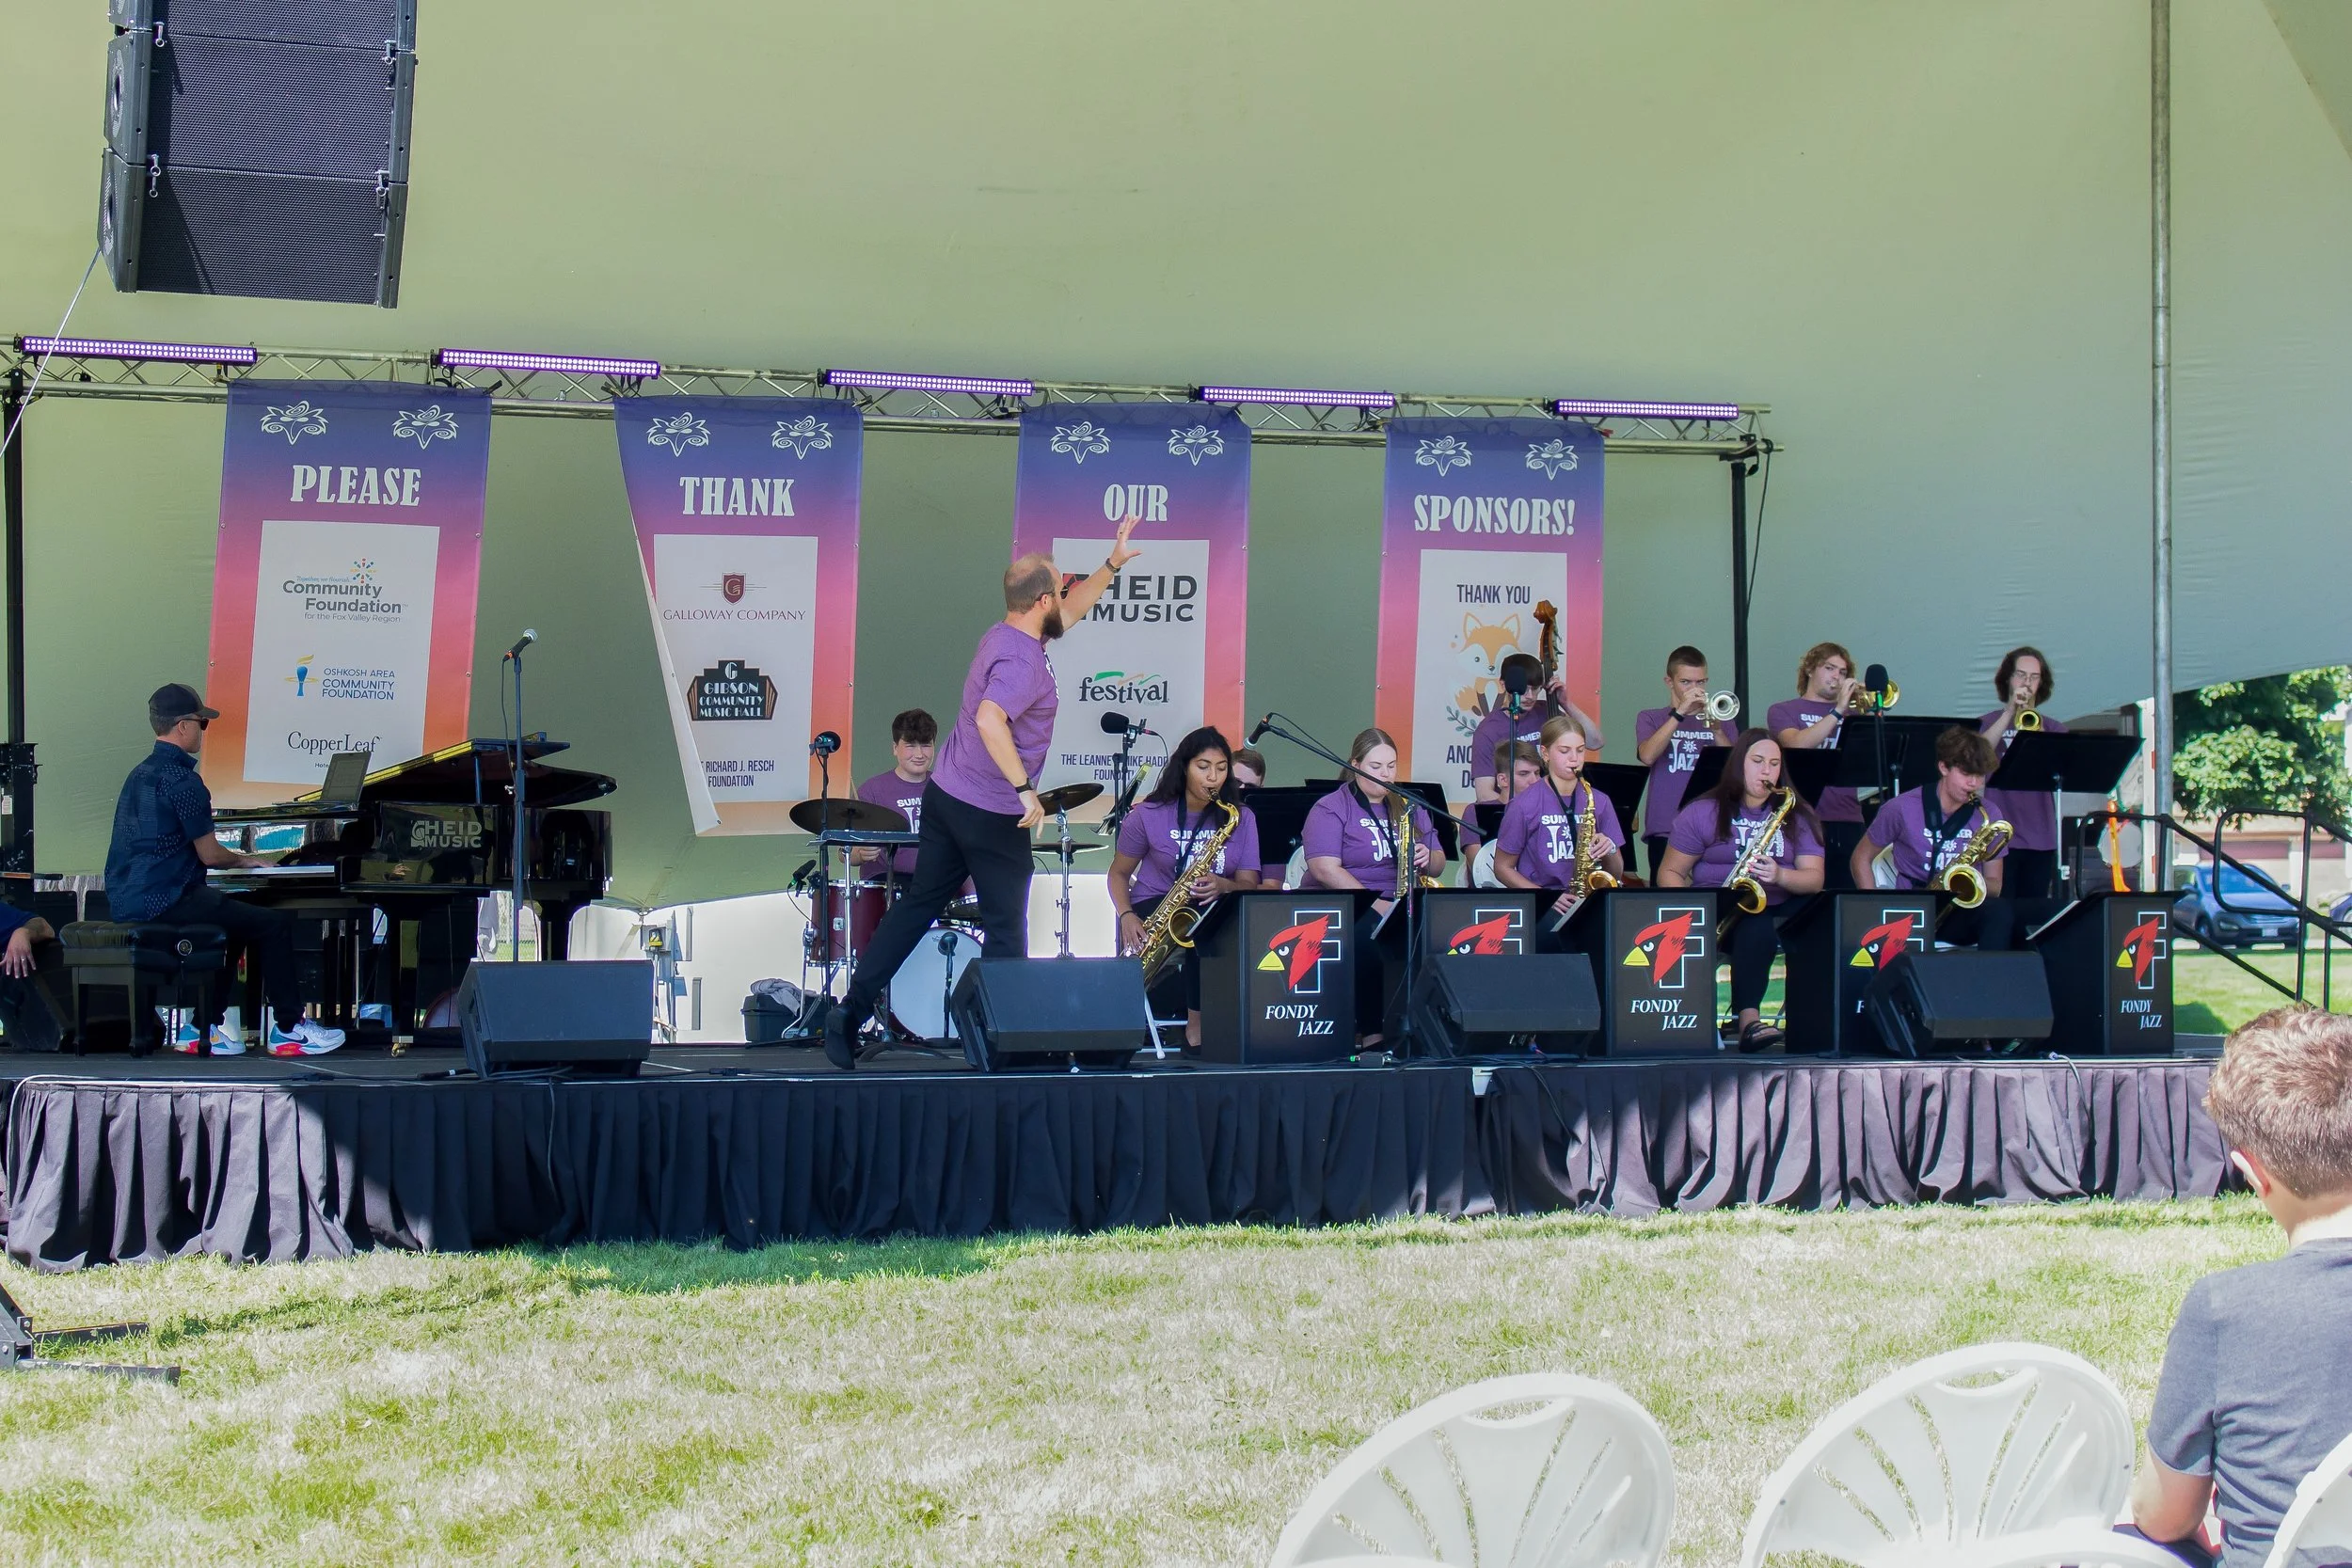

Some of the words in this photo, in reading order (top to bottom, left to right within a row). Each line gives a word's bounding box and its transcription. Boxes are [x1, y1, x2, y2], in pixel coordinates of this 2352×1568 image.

[290, 465, 421, 507] PLEASE
[679, 476, 795, 517] THANK
[1104, 483, 1168, 522] OUR
[1414, 494, 1576, 535] SPONSORS!
[282, 579, 383, 598] Community
[1456, 584, 1501, 604] THANK
[1505, 585, 1531, 604] YOU
[305, 597, 402, 613] Foundation
[317, 612, 330, 621] the
[348, 613, 371, 623] Valley
[372, 614, 401, 624] Region
[663, 610, 734, 620] GALLOWAY
[737, 610, 806, 621] COMPANY
[1092, 603, 1194, 623] MUSIC
[324, 668, 367, 677] OSHKOSH
[370, 670, 395, 678] AREA
[323, 678, 395, 690] COMMUNITY
[704, 682, 759, 695] GIBSON
[1079, 676, 1168, 705] festival
[322, 689, 394, 700] FOUNDATION
[699, 696, 764, 705] COMMUNITY
[699, 707, 733, 717] MUSIC
[735, 707, 763, 717] HALL
[1673, 730, 1714, 740] UMMER
[288, 731, 381, 755] CopperLeaf
[1061, 753, 1077, 766] THE
[1079, 754, 1112, 767] LEANNE
[1669, 738, 1700, 773] JAZ
[706, 760, 738, 773] RICHARD
[739, 761, 745, 772] J.
[748, 760, 774, 772] RESCH
[707, 774, 755, 788] FOUNDATION
[425, 820, 482, 835] HEID
[425, 835, 482, 848] MUSIC
[1547, 825, 1576, 863] JAZ
[1264, 1004, 1318, 1020] FONDY
[1630, 999, 1682, 1013] FONDY
[2121, 1000, 2153, 1014] FONDY
[1297, 1021, 1334, 1037] JAZZ
[1661, 1015, 1697, 1031] JAZZ
[2140, 1014, 2162, 1030] JAZZ
